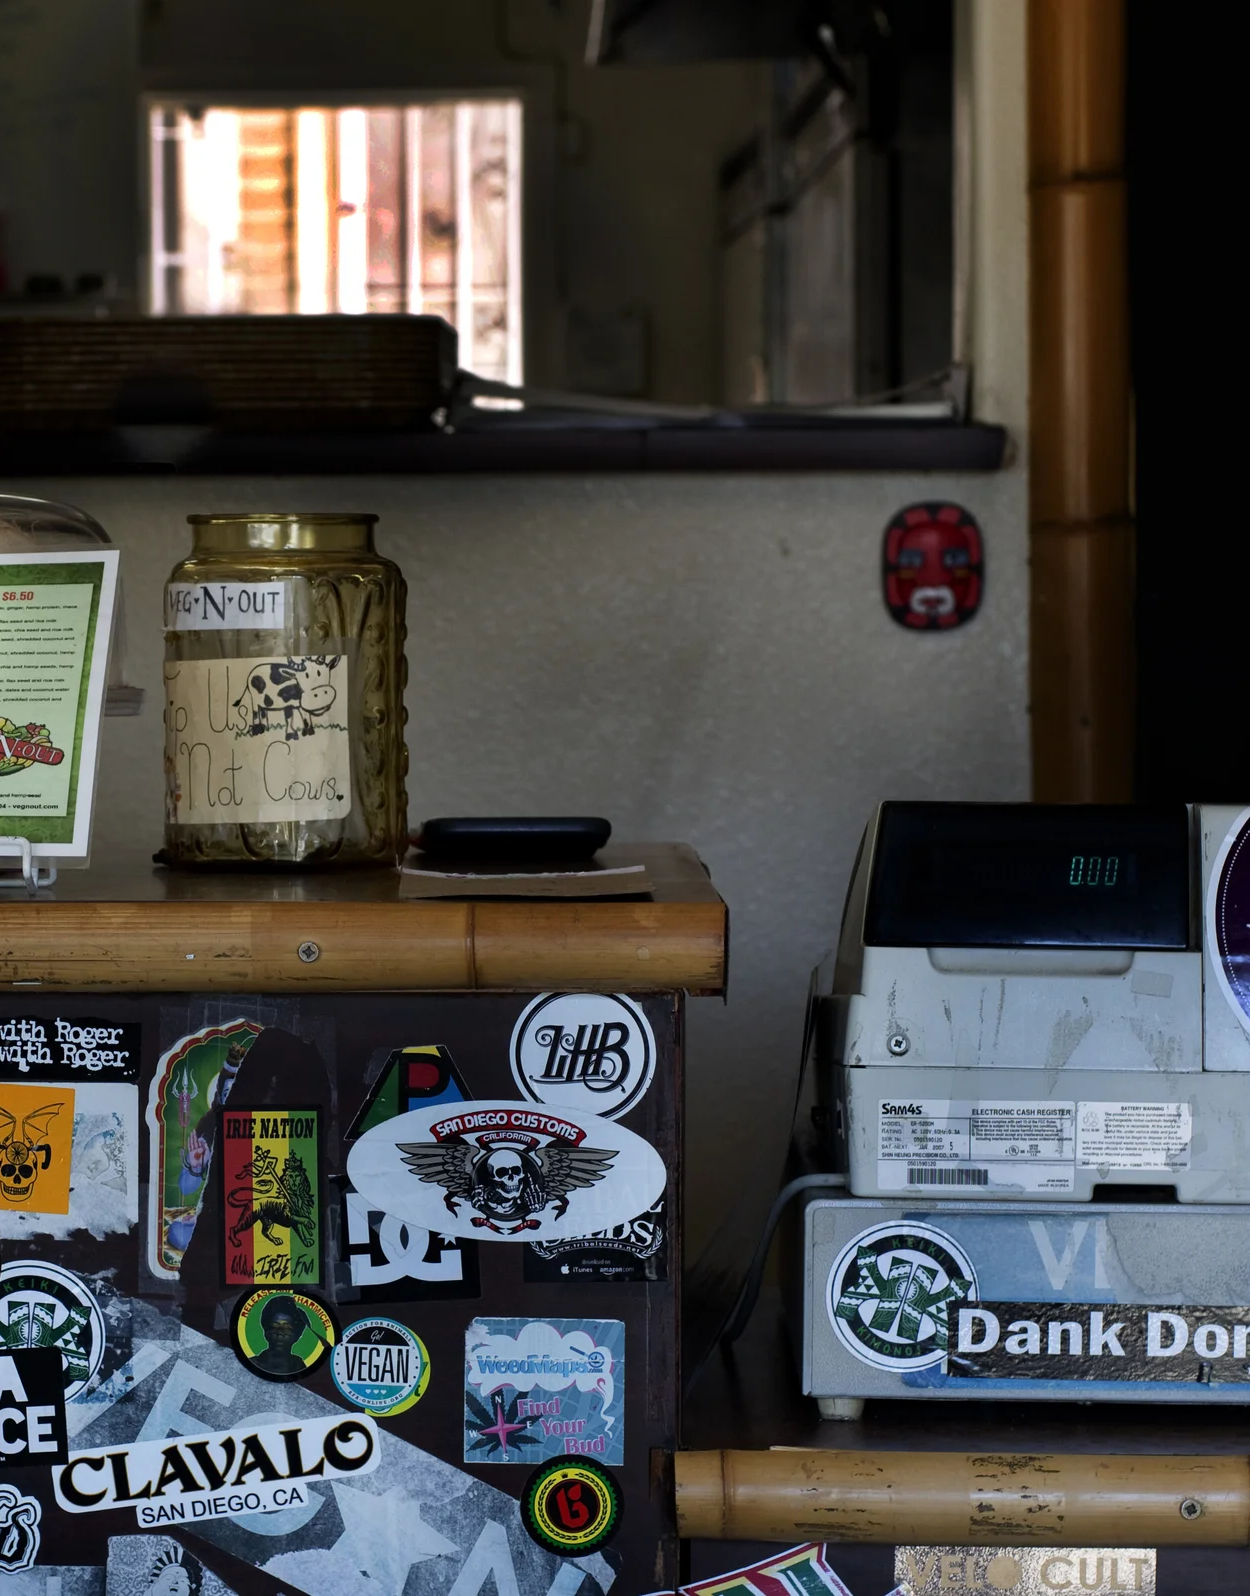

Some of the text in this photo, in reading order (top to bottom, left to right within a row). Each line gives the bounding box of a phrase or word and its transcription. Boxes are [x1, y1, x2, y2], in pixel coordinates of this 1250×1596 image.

[2, 591, 34, 601] $6.50
[200, 585, 227, 621] N
[238, 589, 280, 614] OUT
[207, 665, 249, 733] Us
[21, 745, 60, 762] OUT
[54, 1018, 124, 1046] Roger
[60, 1043, 129, 1069] Roger
[225, 1116, 316, 1141] IRIE NATION
[435, 1112, 580, 1141] SAN DIEGO CUSTOMS
[483, 1132, 532, 1144] CALIFORNIA
[551, 1240, 641, 1254] www.tribalseeds.net
[891, 1237, 946, 1262] KEIKI
[572, 1266, 593, 1274] iTunes
[3, 1277, 59, 1296] KEIKI
[240, 1288, 274, 1319] RELEASE
[344, 1322, 368, 1340] ACTION
[386, 1321, 412, 1342] ANIMALS
[856, 1326, 922, 1357] KIMONOS
[957, 1307, 1126, 1357] Dank
[344, 1345, 410, 1384] VEGAN
[495, 1395, 502, 1404] N
[516, 1396, 562, 1417] Find
[469, 1430, 479, 1438] W
[526, 1420, 533, 1429] E
[540, 1418, 587, 1436] Your
[564, 1436, 606, 1455] Bud
[59, 1419, 375, 1507] CLAVALO
[502, 1453, 509, 1462] S
[141, 1487, 305, 1524] SAN DIEGO, CA
[905, 1553, 1151, 1591] VELO CULT
